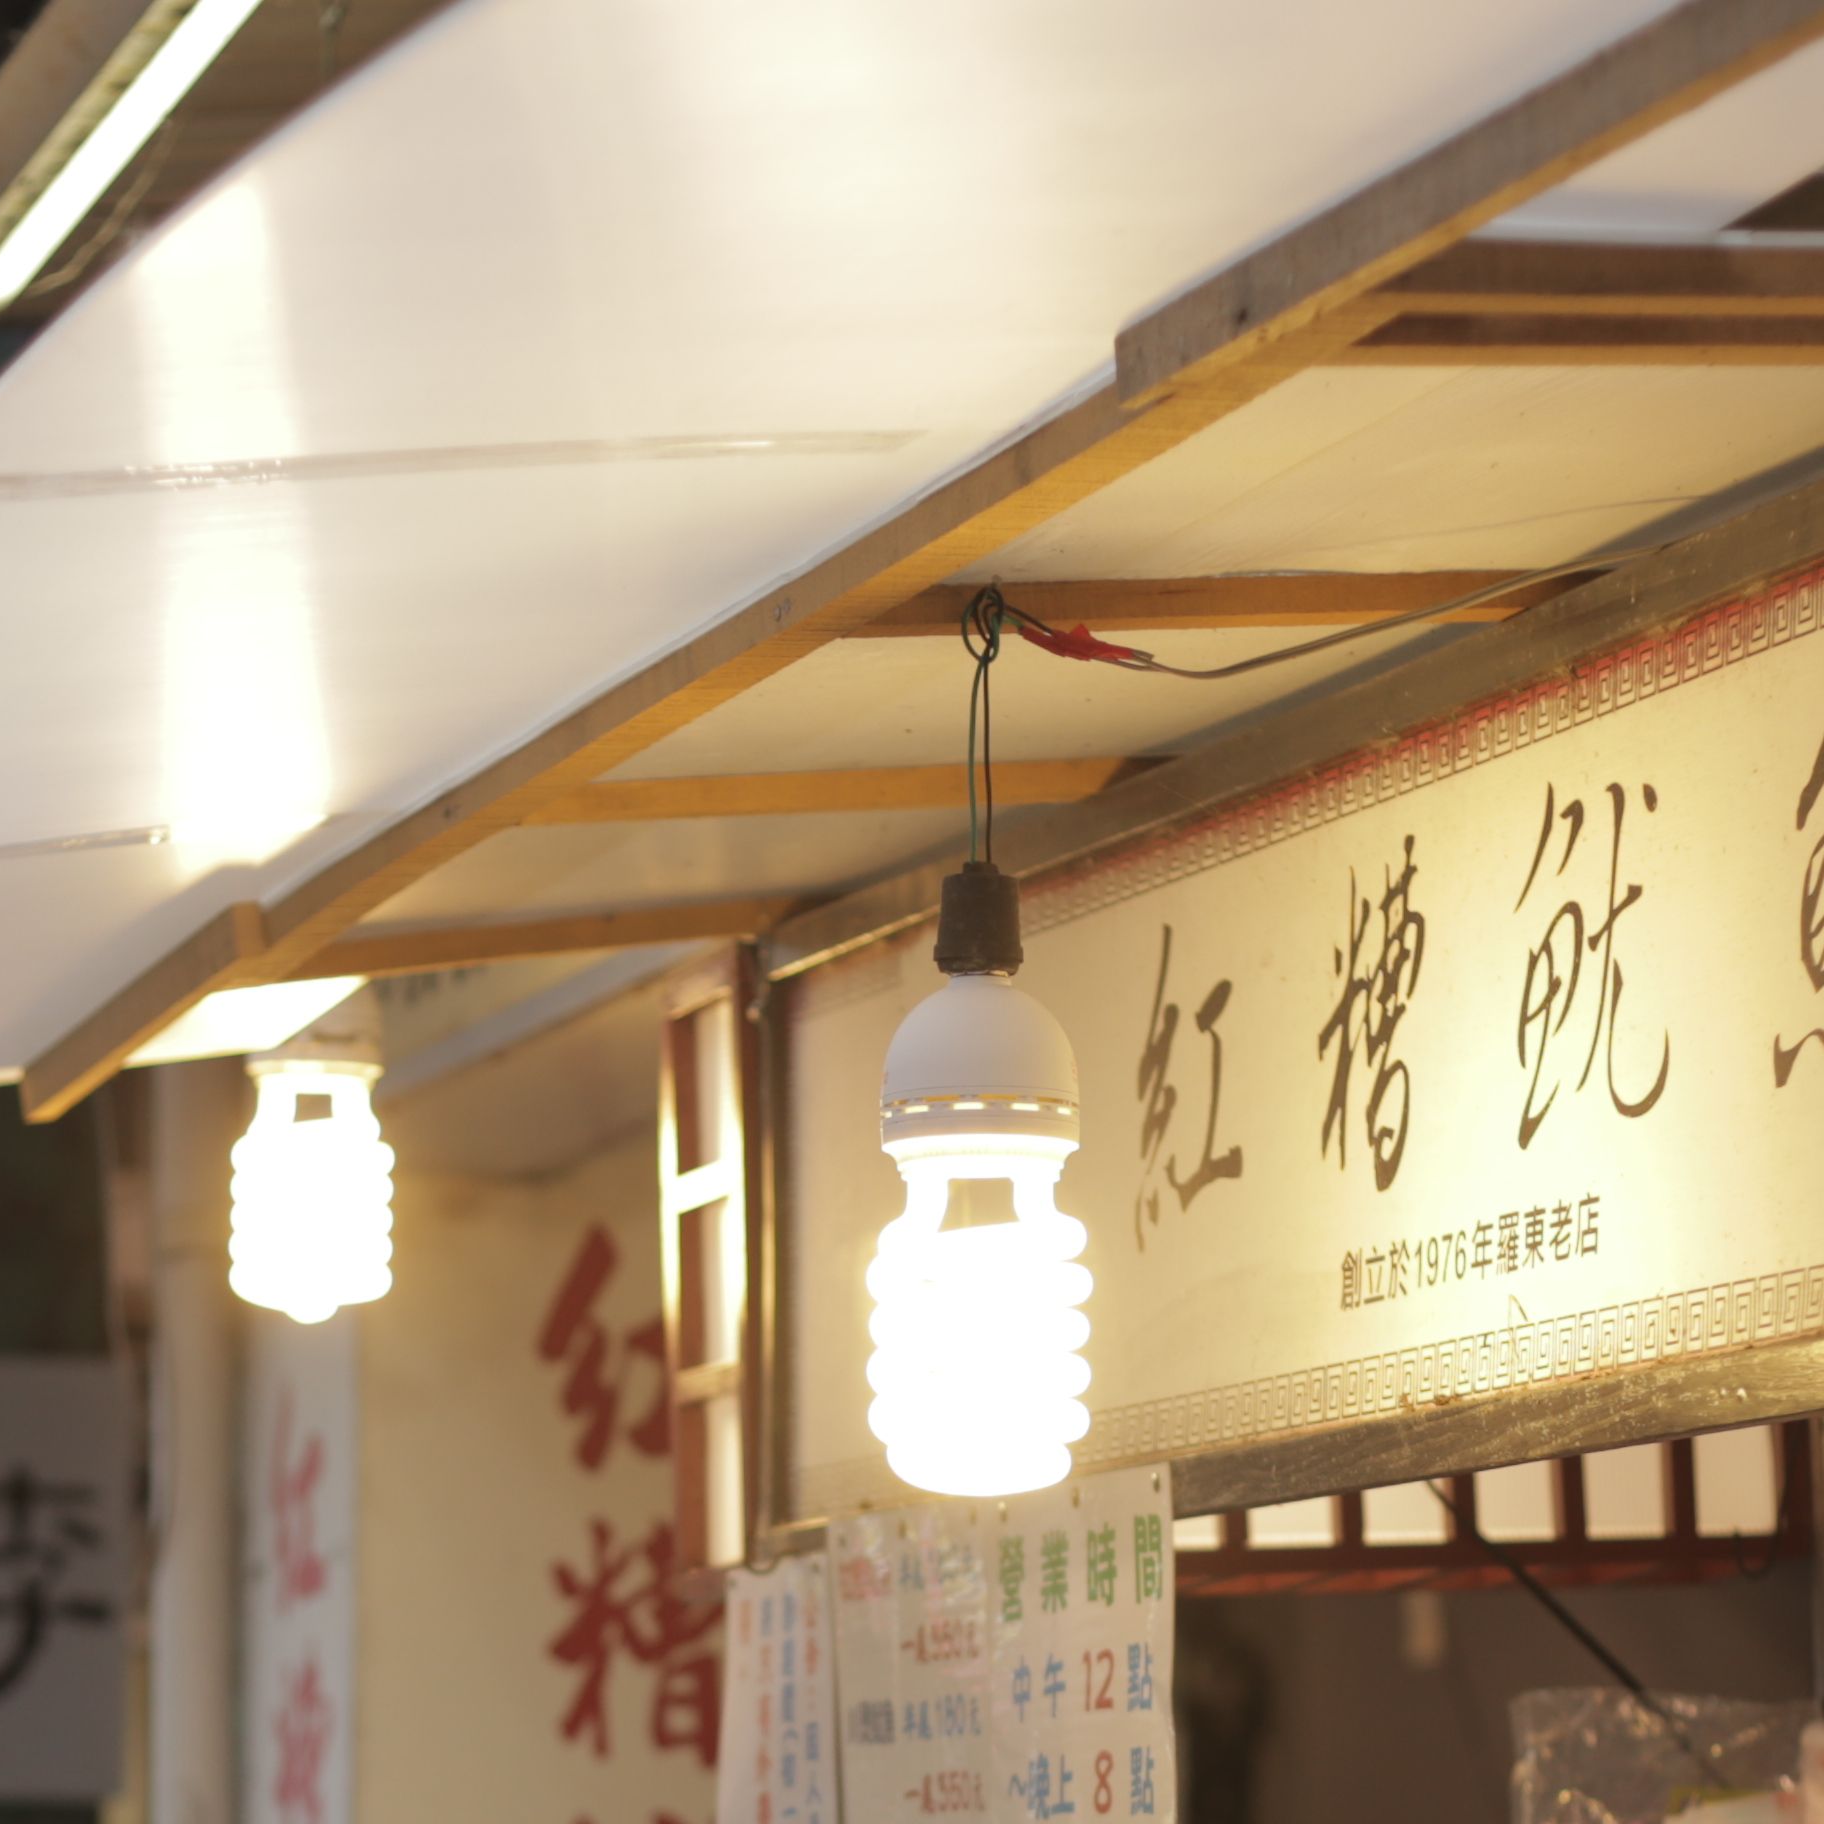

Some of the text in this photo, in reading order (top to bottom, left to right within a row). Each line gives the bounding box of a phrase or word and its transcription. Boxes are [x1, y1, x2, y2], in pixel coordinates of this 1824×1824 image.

[1339, 1192, 1600, 1311] 創立於1976年羅東老店
[998, 1514, 1163, 1623] 營業時間
[1013, 1643, 1153, 1723] 中午12點
